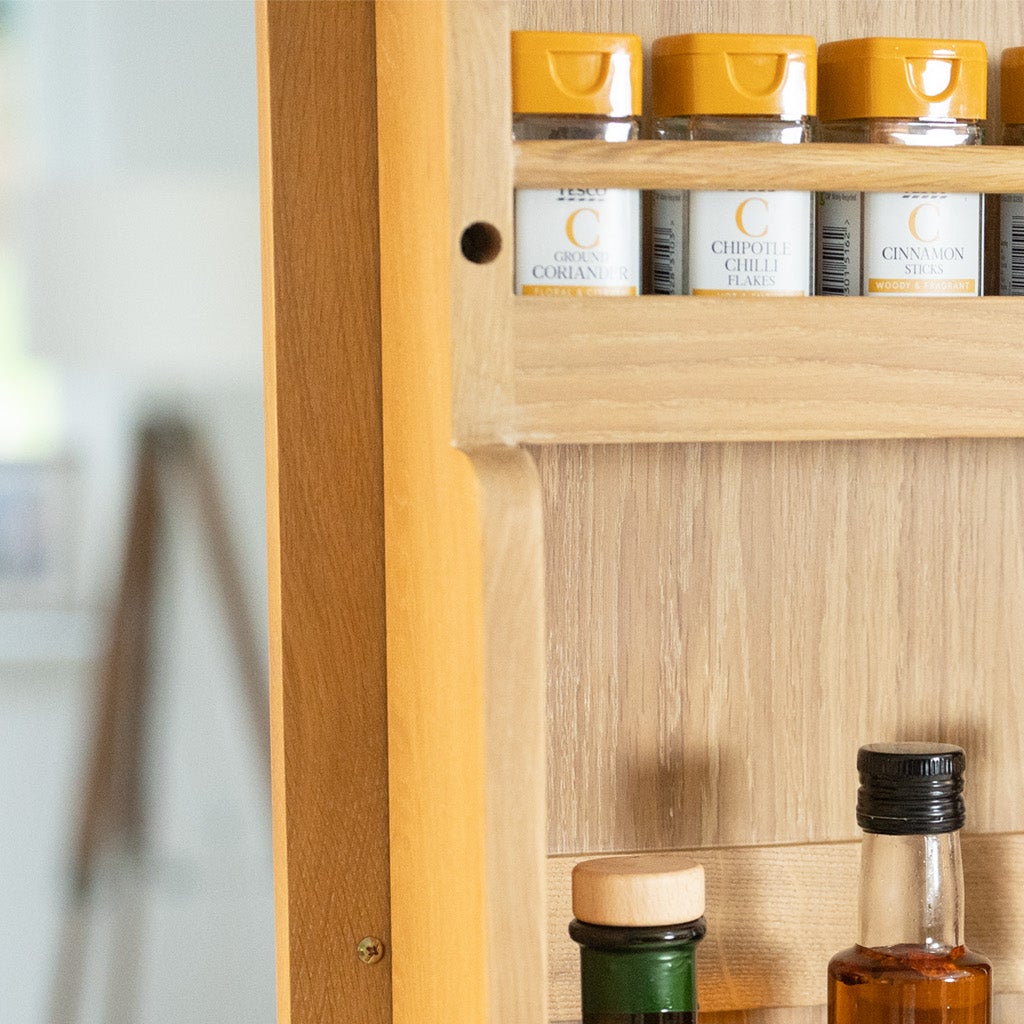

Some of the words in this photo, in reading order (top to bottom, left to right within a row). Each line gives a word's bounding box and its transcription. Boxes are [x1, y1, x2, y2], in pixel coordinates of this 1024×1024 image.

[735, 197, 768, 238] C
[908, 203, 940, 243] C
[565, 208, 600, 249] C
[711, 240, 791, 255] CHIPOTLE
[882, 246, 964, 261] CINNAMON
[553, 251, 609, 263] GROUND
[532, 264, 629, 280] CORIANDER
[725, 258, 778, 272] CHILLI
[905, 263, 944, 275] STICKS
[728, 275, 775, 286] FLAKES
[875, 281, 911, 290] WOODY
